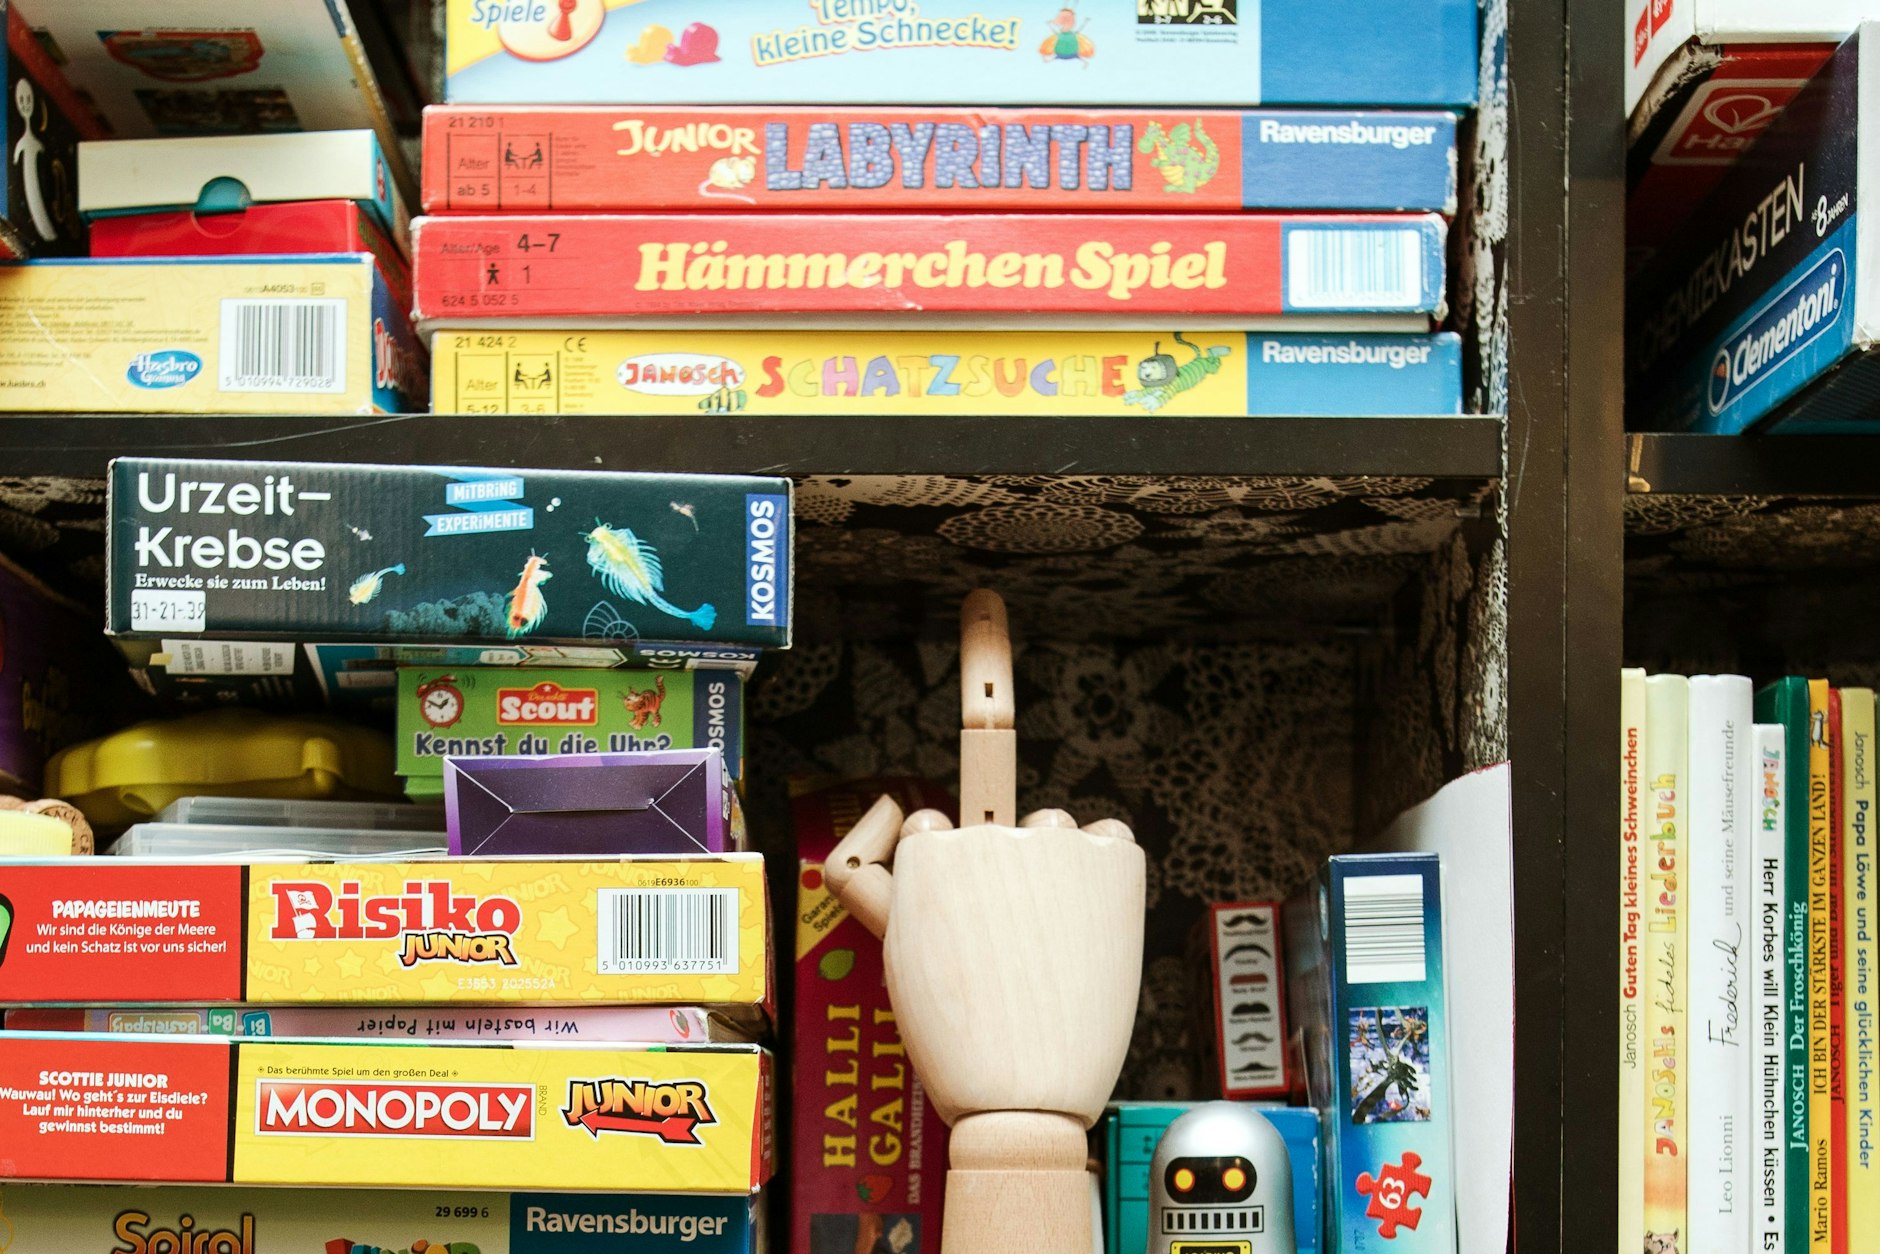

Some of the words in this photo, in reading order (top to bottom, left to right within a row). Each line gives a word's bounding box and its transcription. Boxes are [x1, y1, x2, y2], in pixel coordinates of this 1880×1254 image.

[755, 34, 848, 63] kleine
[858, 20, 1017, 47] Schnecke!
[613, 120, 761, 156] JUNIOR
[765, 121, 1133, 192] LABYRINTH
[1260, 121, 1436, 150] Ravensburger
[634, 240, 1065, 292] Hämmerchen
[1070, 240, 1228, 300] Spiel
[1732, 262, 1838, 386] Clementoni
[131, 354, 200, 376] Hasbro
[1261, 341, 1431, 369] Ravensburger
[755, 355, 1129, 399] SCHATZSUCHE
[134, 527, 326, 571] Krebse
[751, 500, 775, 621] KOSMOS
[135, 573, 203, 589] Erwecke
[206, 575, 229, 589] sie
[232, 578, 268, 589] zum
[271, 576, 326, 592] Leben!
[501, 697, 595, 722] Scout
[415, 733, 507, 756] Kennst
[519, 734, 548, 755] du
[560, 734, 598, 754] die
[1855, 731, 1871, 790] Janosch
[1623, 727, 1638, 842] Schweinchen
[1721, 719, 1735, 834] Mäusefreunde
[1811, 774, 1826, 820] LAND!
[1852, 800, 1869, 847] Papa
[1726, 838, 1735, 886] seine
[1763, 858, 1778, 896] Herr
[1812, 823, 1827, 888] GANZEN
[1856, 853, 1871, 901] Löwe
[1624, 845, 1638, 910] kleines
[37, 924, 57, 937] Wir
[59, 923, 85, 937] sind
[87, 923, 107, 936] die
[109, 923, 152, 939] Könige
[154, 923, 175, 936] der
[177, 923, 217, 936] Meere
[52, 900, 200, 919] PAPAGEIENMEUTE
[271, 880, 521, 940] Risiko
[1624, 914, 1641, 946] Tag
[1857, 907, 1872, 942] und
[26, 941, 50, 953] und
[52, 940, 79, 953] kein
[81, 941, 121, 953] Schatz
[123, 941, 138, 953] ist
[139, 942, 160, 953] vor
[163, 942, 185, 953] uns
[187, 941, 227, 953] sicher!
[399, 932, 518, 967] JUNIOR
[1763, 901, 1779, 963] Korbes
[1789, 902, 1808, 1005] Froschkönig
[618, 960, 668, 971] 010993
[673, 960, 721, 971] 637751
[1623, 946, 1638, 999] Guten
[1809, 916, 1827, 994] STÄRKSTE
[1857, 948, 1872, 994] seine
[1708, 921, 1743, 1048] Frederick
[1763, 969, 1779, 997] will
[357, 1014, 418, 1035] Papier
[426, 1017, 455, 1033] mit
[466, 1017, 535, 1033] basteln
[1763, 1003, 1779, 1048] Klein
[1790, 1011, 1804, 1051] Der
[1813, 999, 1827, 1030] DER
[1622, 1004, 1636, 1069] Janosch
[1813, 1037, 1827, 1064] BIN
[1854, 1001, 1873, 1102] glücklichen
[39, 1071, 104, 1087] SCOTTIE
[107, 1072, 168, 1089] JUNIOR
[267, 1066, 284, 1075] Das
[286, 1065, 330, 1075] berühmte
[332, 1067, 354, 1077] Spiel
[373, 1068, 390, 1077] den
[429, 1069, 450, 1078] Deal
[823, 1004, 861, 1168] HALLI
[1813, 1069, 1827, 1095] ICH
[0, 1087, 56, 1100] Wauwau!
[59, 1089, 81, 1101] Wo
[127, 1092, 147, 1103] zur
[150, 1091, 208, 1105] Eisdiele?
[23, 1104, 50, 1117] Lauf
[53, 1105, 74, 1117] mir
[76, 1105, 137, 1118] hinterher
[138, 1107, 163, 1119] und
[165, 1107, 183, 1119] du
[265, 1088, 527, 1131] MONOPOLY
[561, 1079, 718, 1126] JUNIOR
[1763, 1054, 1780, 1141] Hühnchen
[1790, 1064, 1809, 1152] JANOSCH
[39, 1120, 97, 1133] gewinnst
[99, 1120, 165, 1134] bestimmt!
[1719, 1114, 1734, 1178] Lionni
[1858, 1109, 1874, 1170] Kinder
[1764, 1150, 1781, 1208] küssen
[1814, 1138, 1827, 1191] Ramos
[435, 1206, 451, 1218] 29
[453, 1207, 478, 1219] 699
[1379, 1177, 1406, 1210] 63
[1719, 1182, 1733, 1215] Leo
[527, 1207, 728, 1241] Ravensburger
[1814, 1195, 1828, 1243] Mario
[1764, 1232, 1779, 1252] Es
